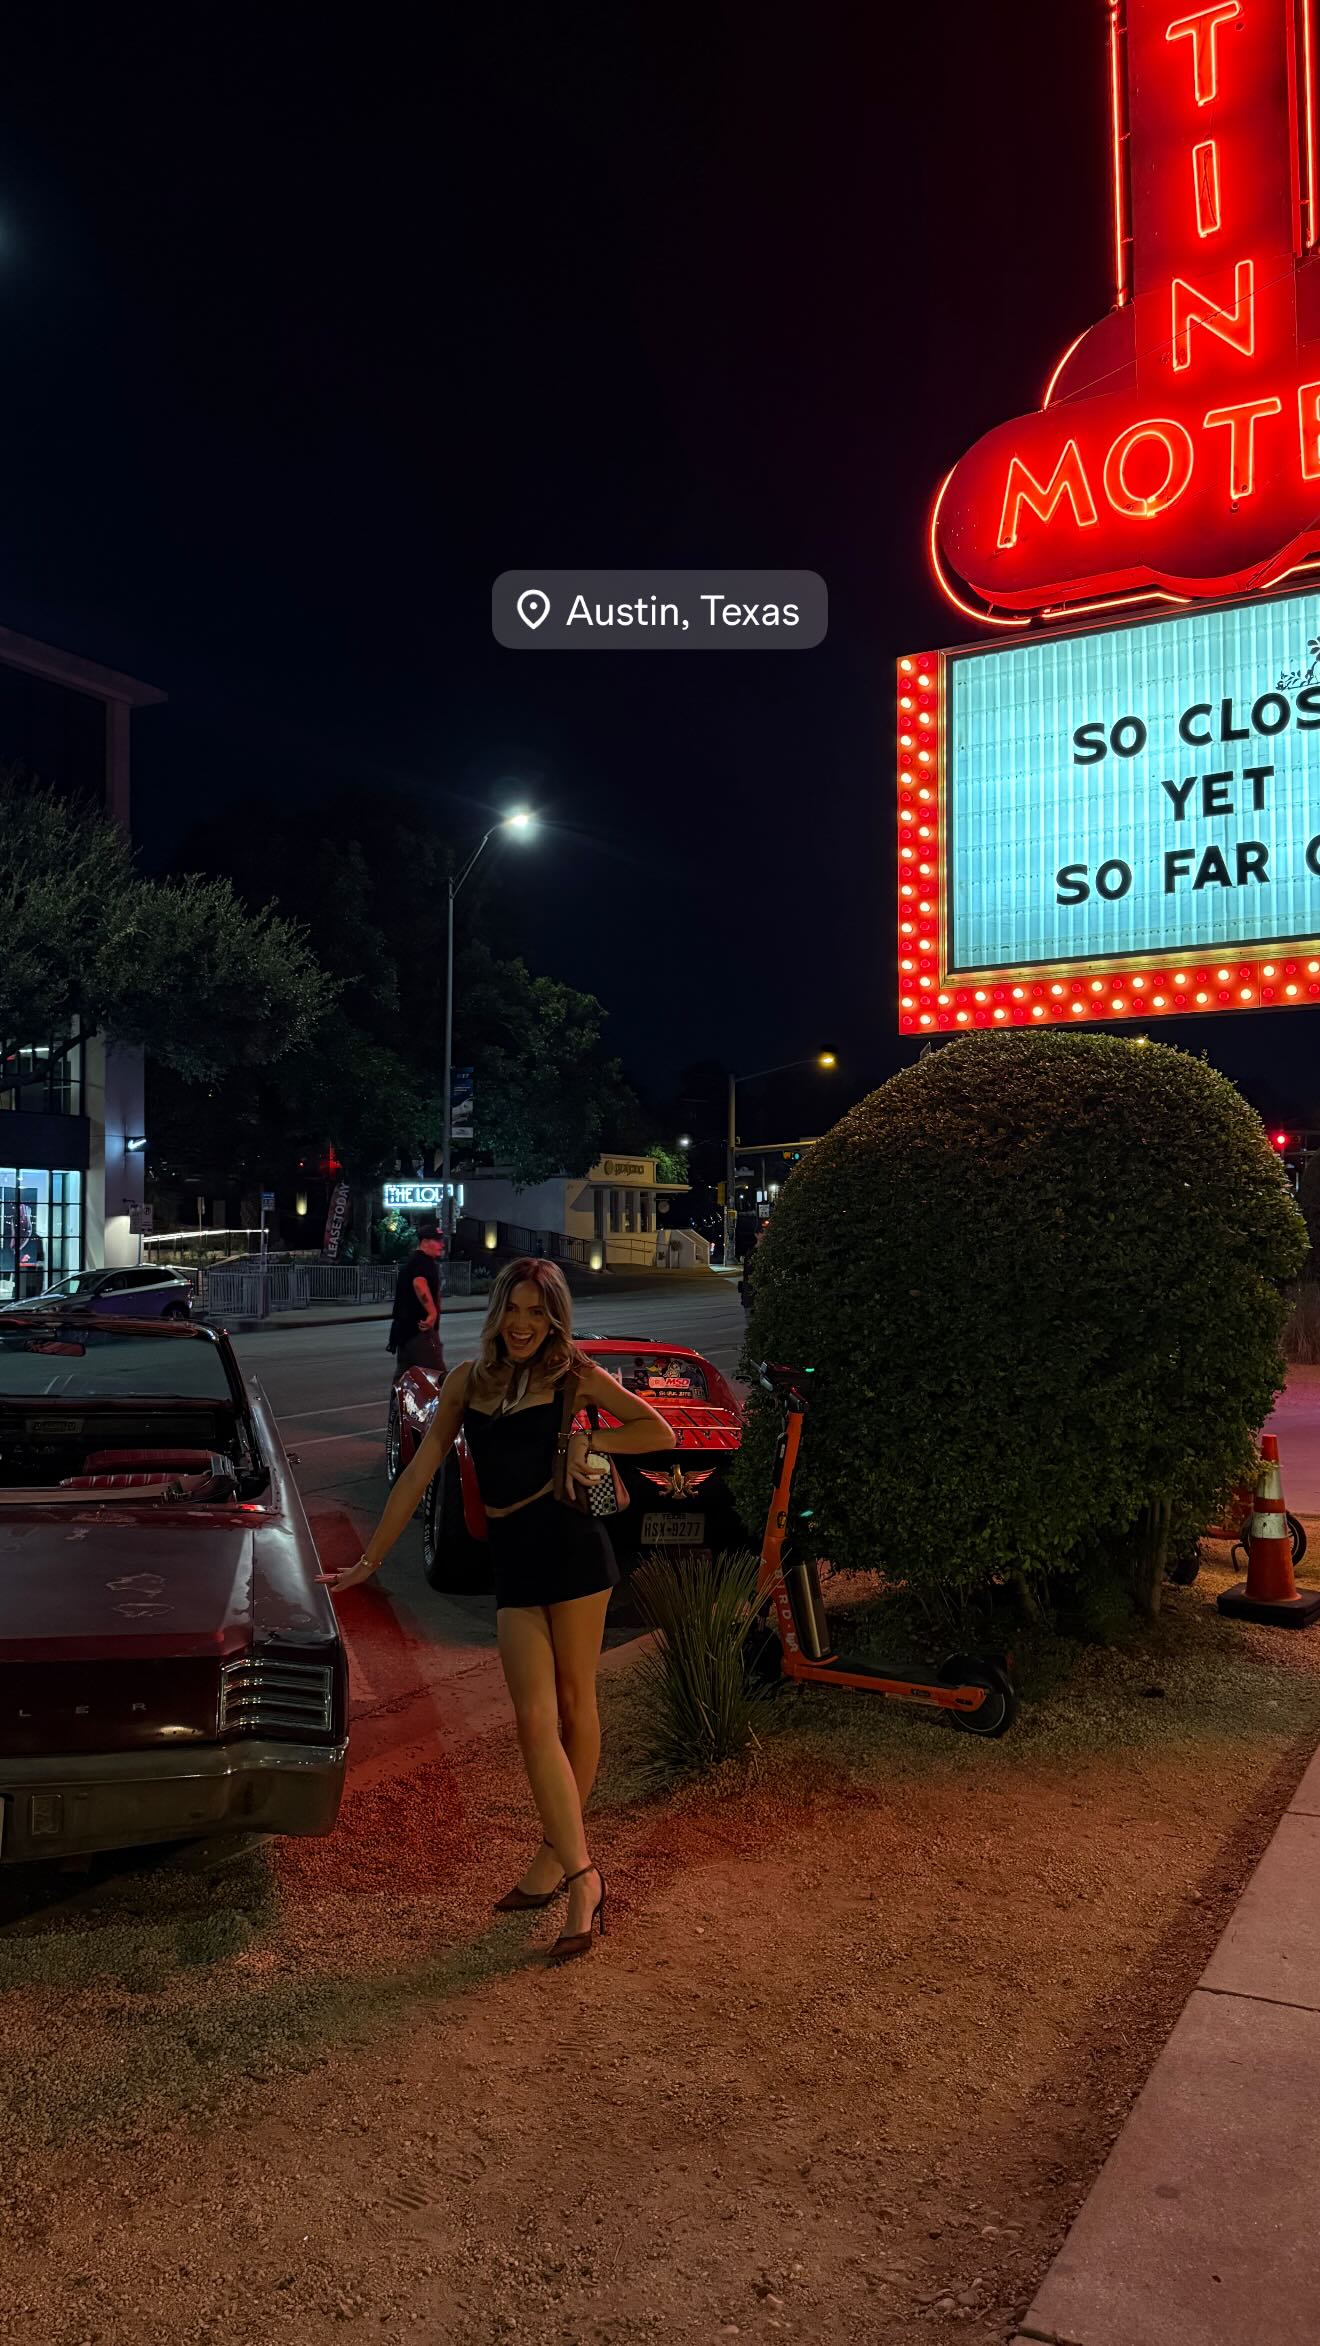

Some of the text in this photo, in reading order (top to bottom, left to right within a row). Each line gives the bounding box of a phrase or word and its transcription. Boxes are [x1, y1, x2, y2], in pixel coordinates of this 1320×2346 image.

[1072, 685, 1320, 766] SO CLOS
[1160, 765, 1275, 822] YET
[1055, 858, 1133, 906] SO
[1163, 840, 1271, 895] FAR
[327, 1182, 351, 1258] LEASE TODAY
[388, 1187, 414, 1203] THE
[665, 1378, 690, 1386] MSD
